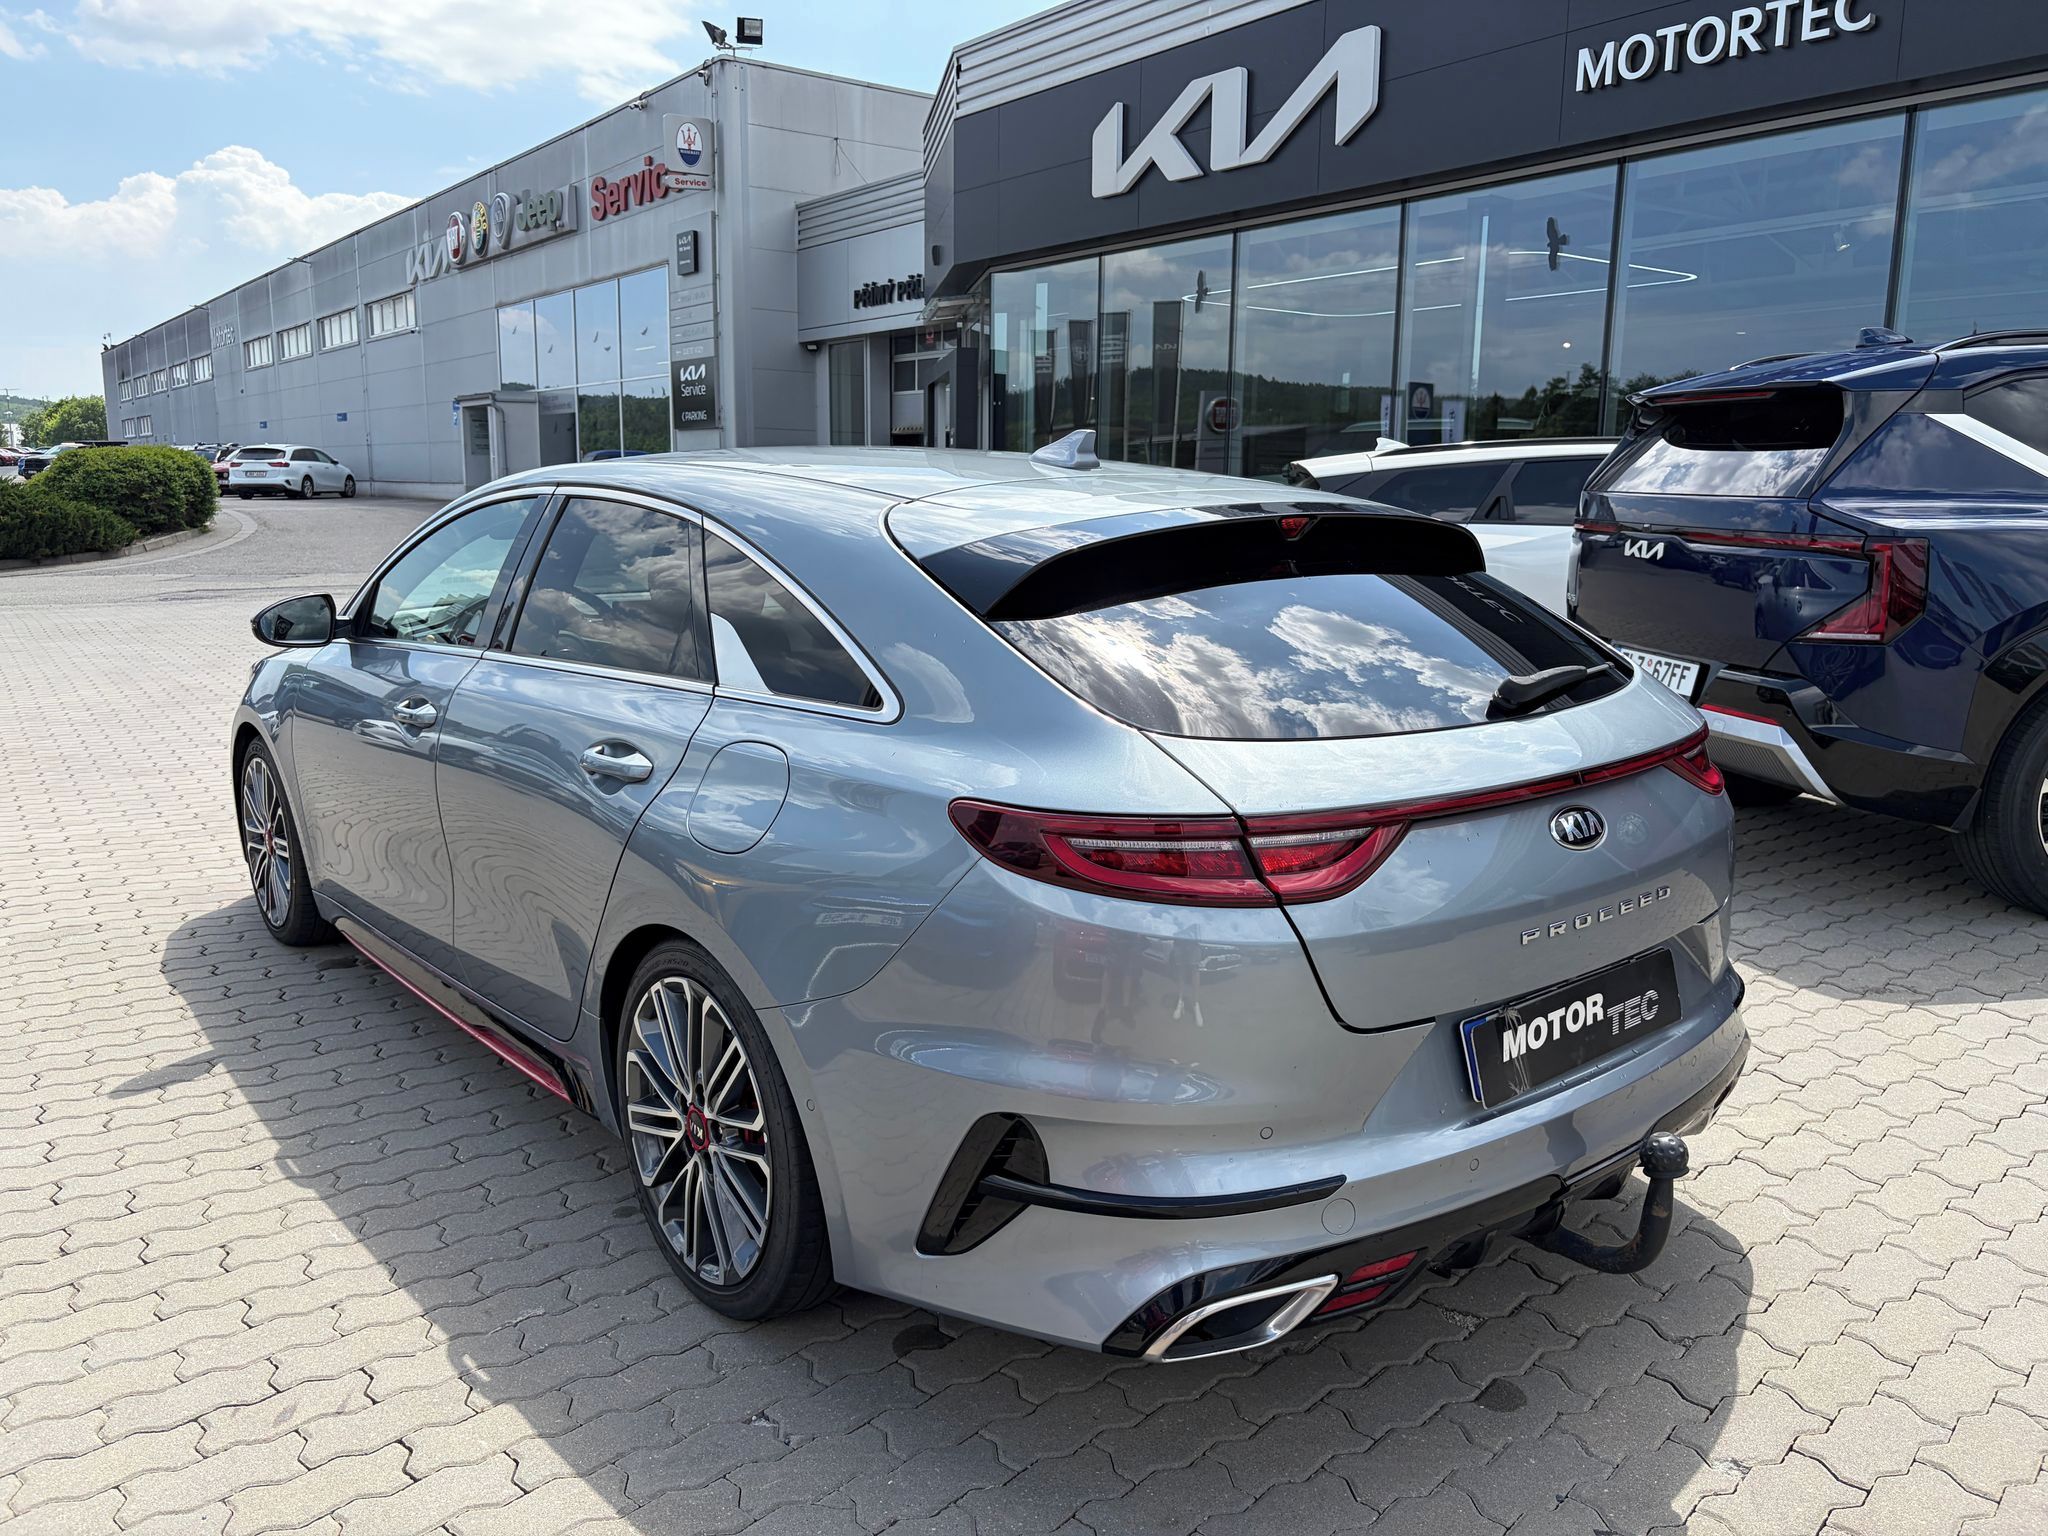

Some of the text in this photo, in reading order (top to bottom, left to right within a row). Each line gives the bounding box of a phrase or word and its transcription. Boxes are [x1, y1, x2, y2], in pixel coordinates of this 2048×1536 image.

[1576, 0, 1876, 93] MOTORTEC
[1091, 25, 1382, 199] KIA
[591, 156, 682, 221] Servic
[675, 178, 707, 187] Service
[516, 189, 563, 232] Jeep
[406, 242, 450, 286] KIA
[854, 278, 896, 310] PŘÍMÝ
[680, 363, 706, 382] KIA
[680, 382, 707, 397] Service
[1623, 538, 1665, 561] KIA
[1558, 811, 1603, 842] KIA
[1520, 885, 1672, 945] PROCEED
[1503, 989, 1660, 1063] MOTOR TEC
